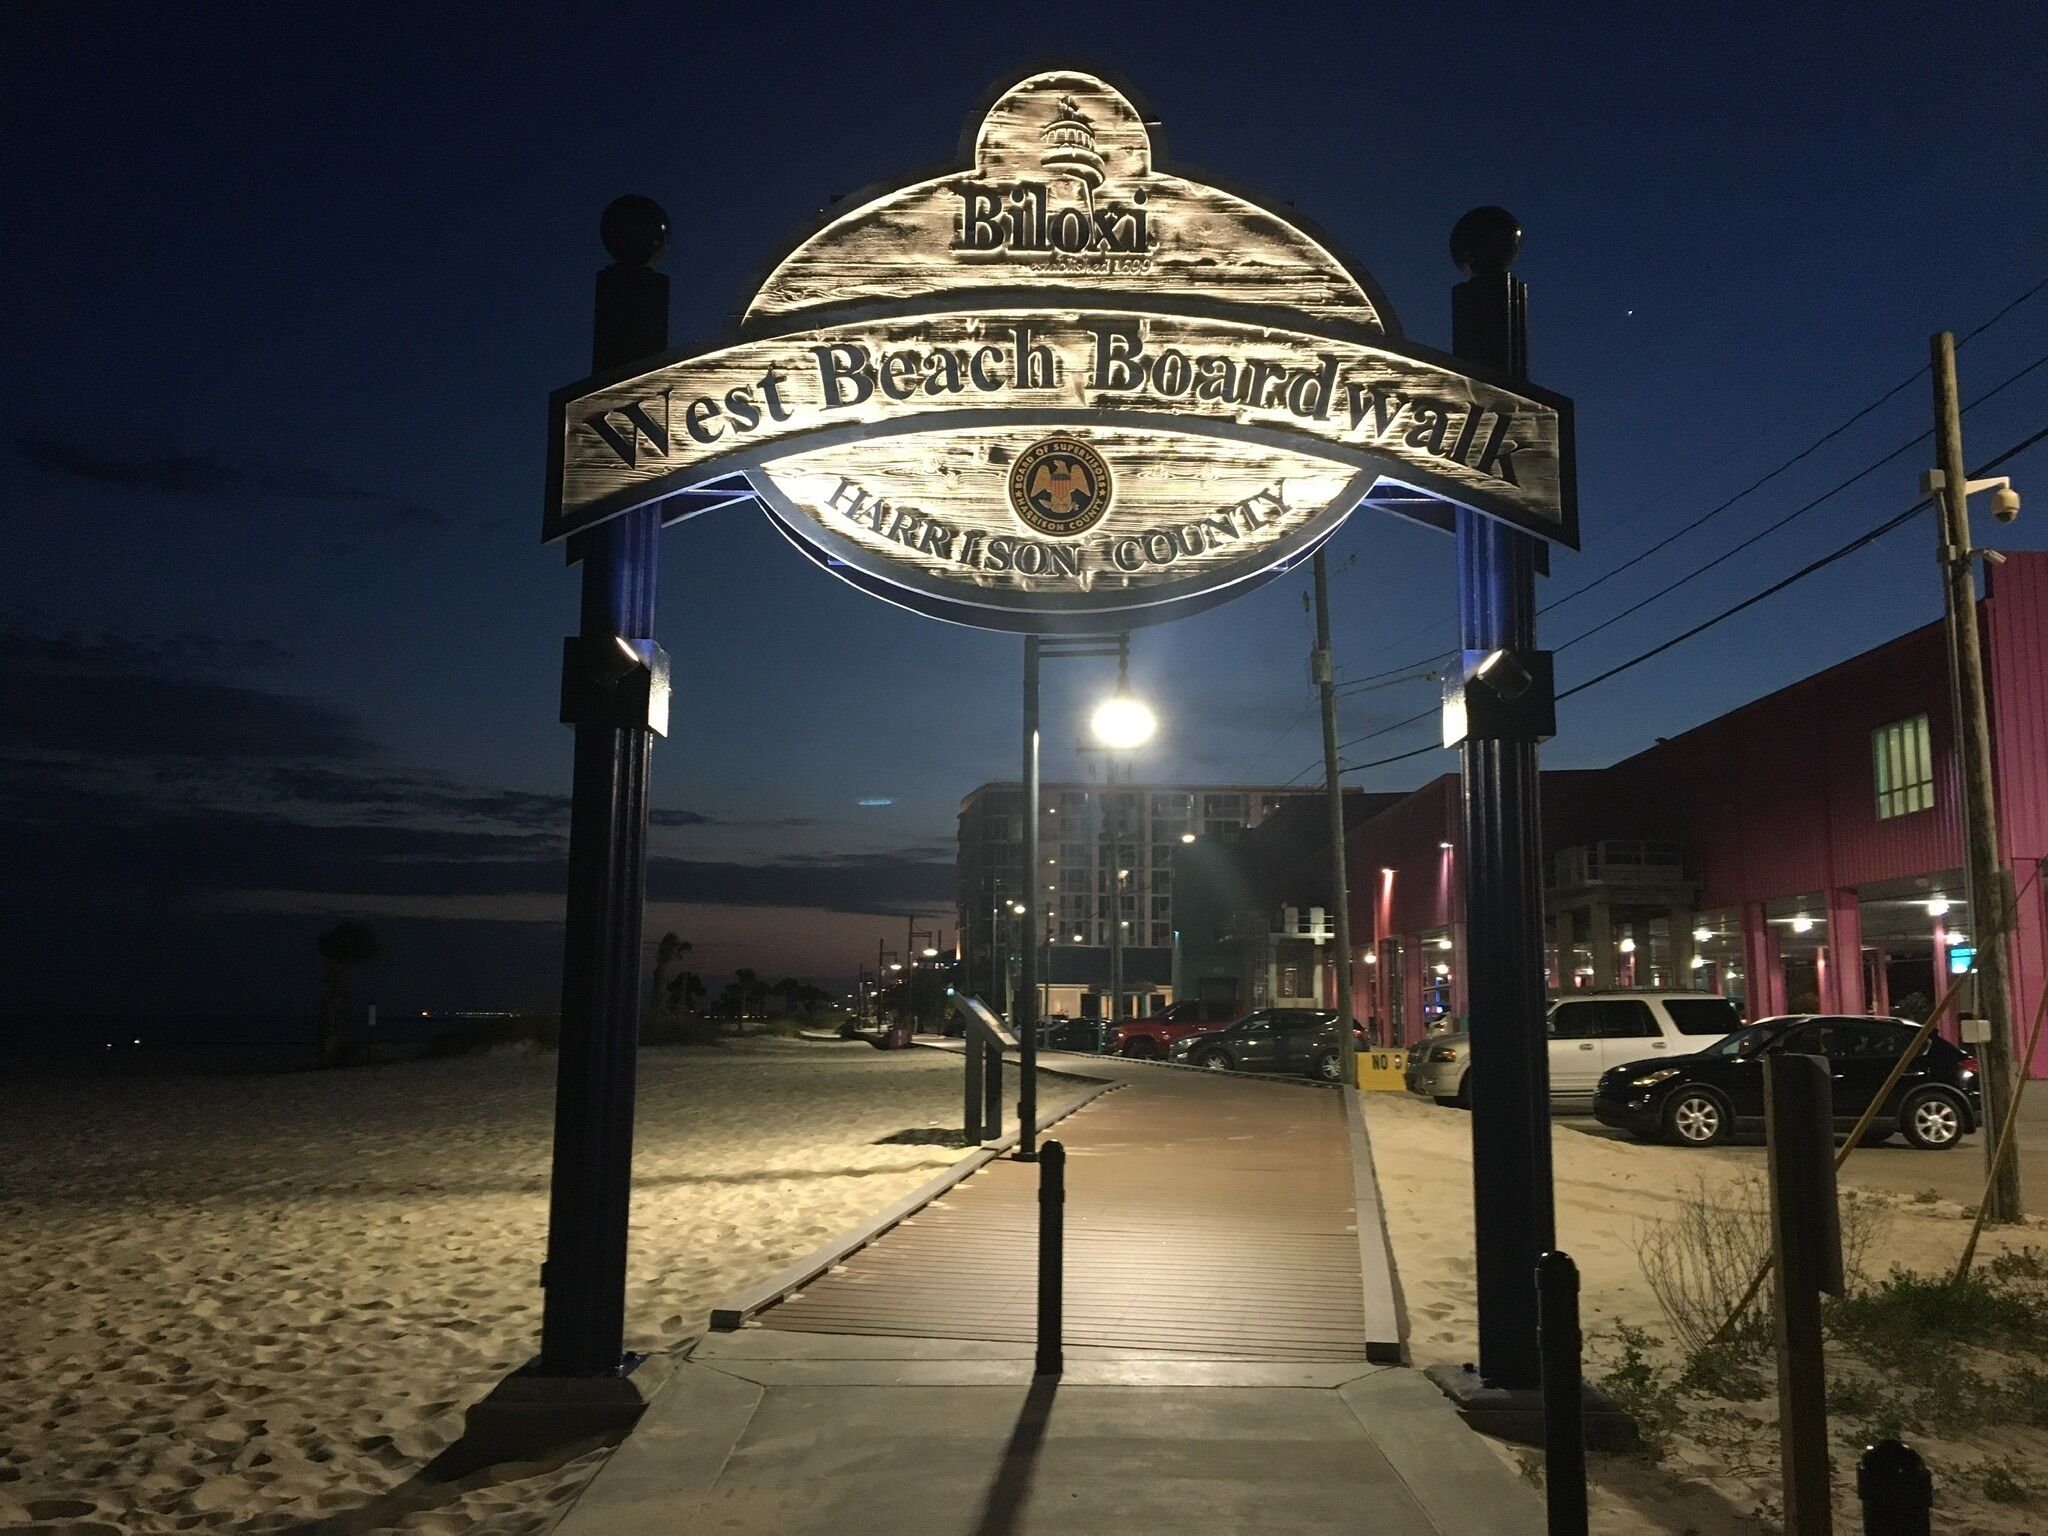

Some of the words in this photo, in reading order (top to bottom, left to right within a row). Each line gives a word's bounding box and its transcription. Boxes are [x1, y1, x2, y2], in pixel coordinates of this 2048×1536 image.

[955, 184, 1152, 254] Biloxi
[584, 364, 795, 470] West
[809, 326, 1061, 412] Beach
[1086, 328, 1534, 488] Boardwalk
[1014, 456, 1034, 488] BOARD
[1035, 445, 1049, 456] OF
[1053, 443, 1106, 488] SUPERVISORS
[823, 476, 1082, 579] HARRISON
[1113, 479, 1295, 575] COUNTY
[1016, 498, 1064, 531] HARRISON
[1069, 499, 1104, 530] COUNTY
[1372, 1054, 1387, 1070] NO
